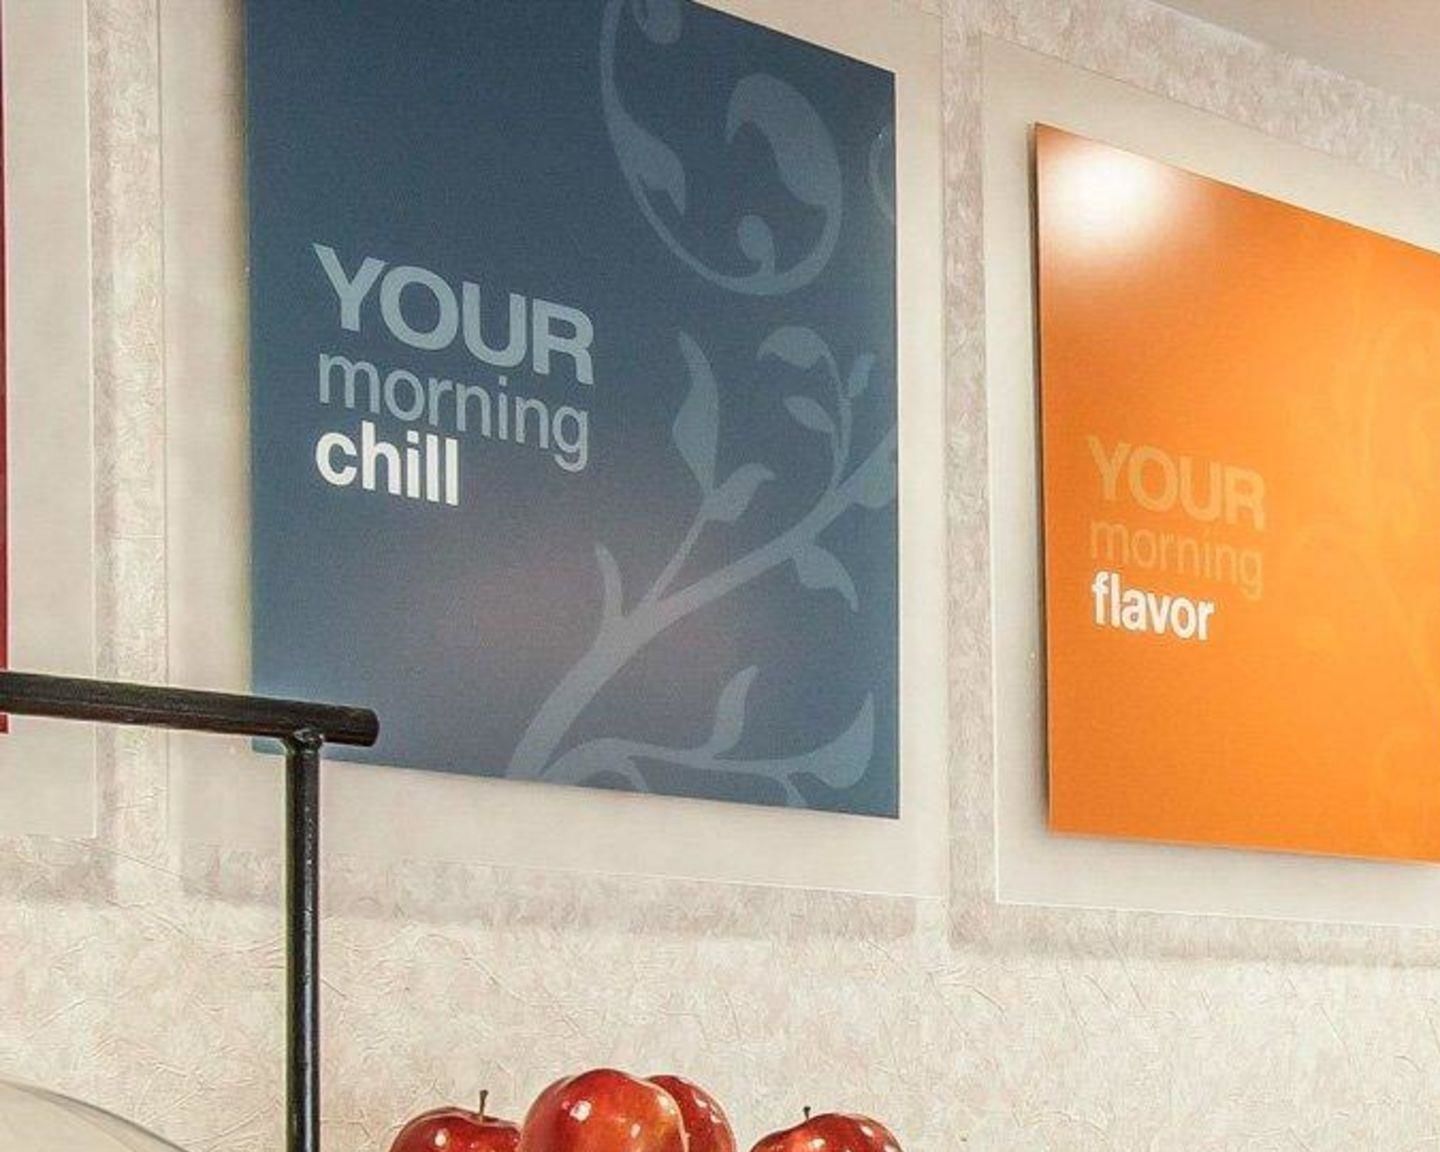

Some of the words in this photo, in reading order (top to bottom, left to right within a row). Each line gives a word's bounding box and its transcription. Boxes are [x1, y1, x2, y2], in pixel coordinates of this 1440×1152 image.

[313, 243, 594, 385] YOUR
[319, 353, 588, 473] morning
[315, 420, 459, 506] chill
[1087, 435, 1266, 531] YOUR
[1090, 519, 1264, 601] morning
[1092, 570, 1216, 641] flavor
